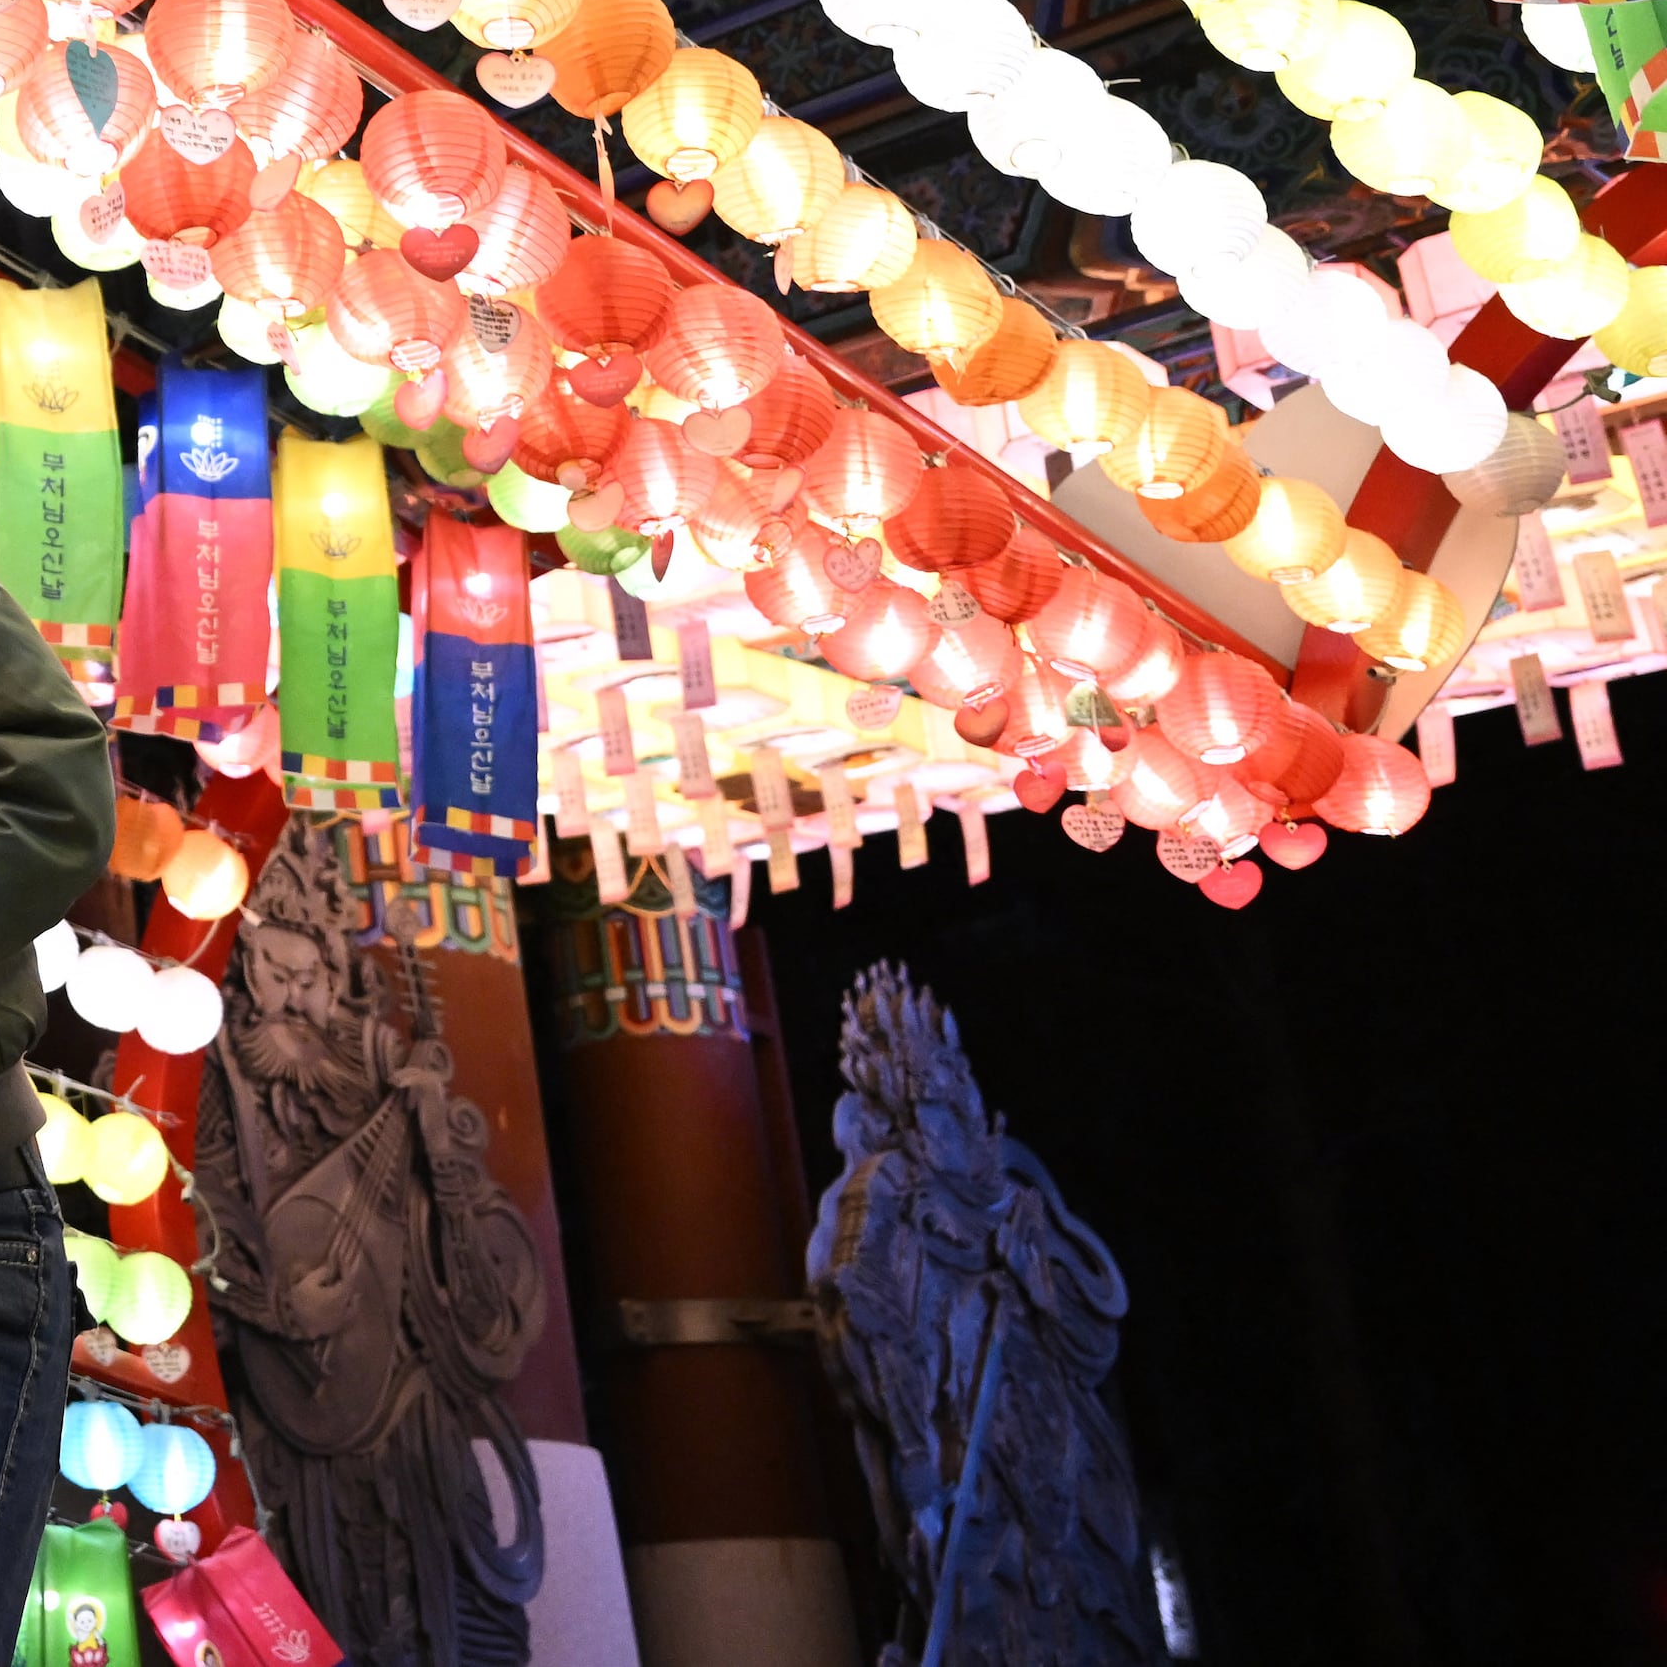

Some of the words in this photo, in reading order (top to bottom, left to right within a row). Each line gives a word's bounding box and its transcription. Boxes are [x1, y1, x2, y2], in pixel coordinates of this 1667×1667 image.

[40, 451, 65, 601] 부처님오신날
[195, 518, 221, 665] 부처님오신날
[326, 598, 348, 740] 부처님오신날
[469, 660, 496, 796] 부처님오신날
